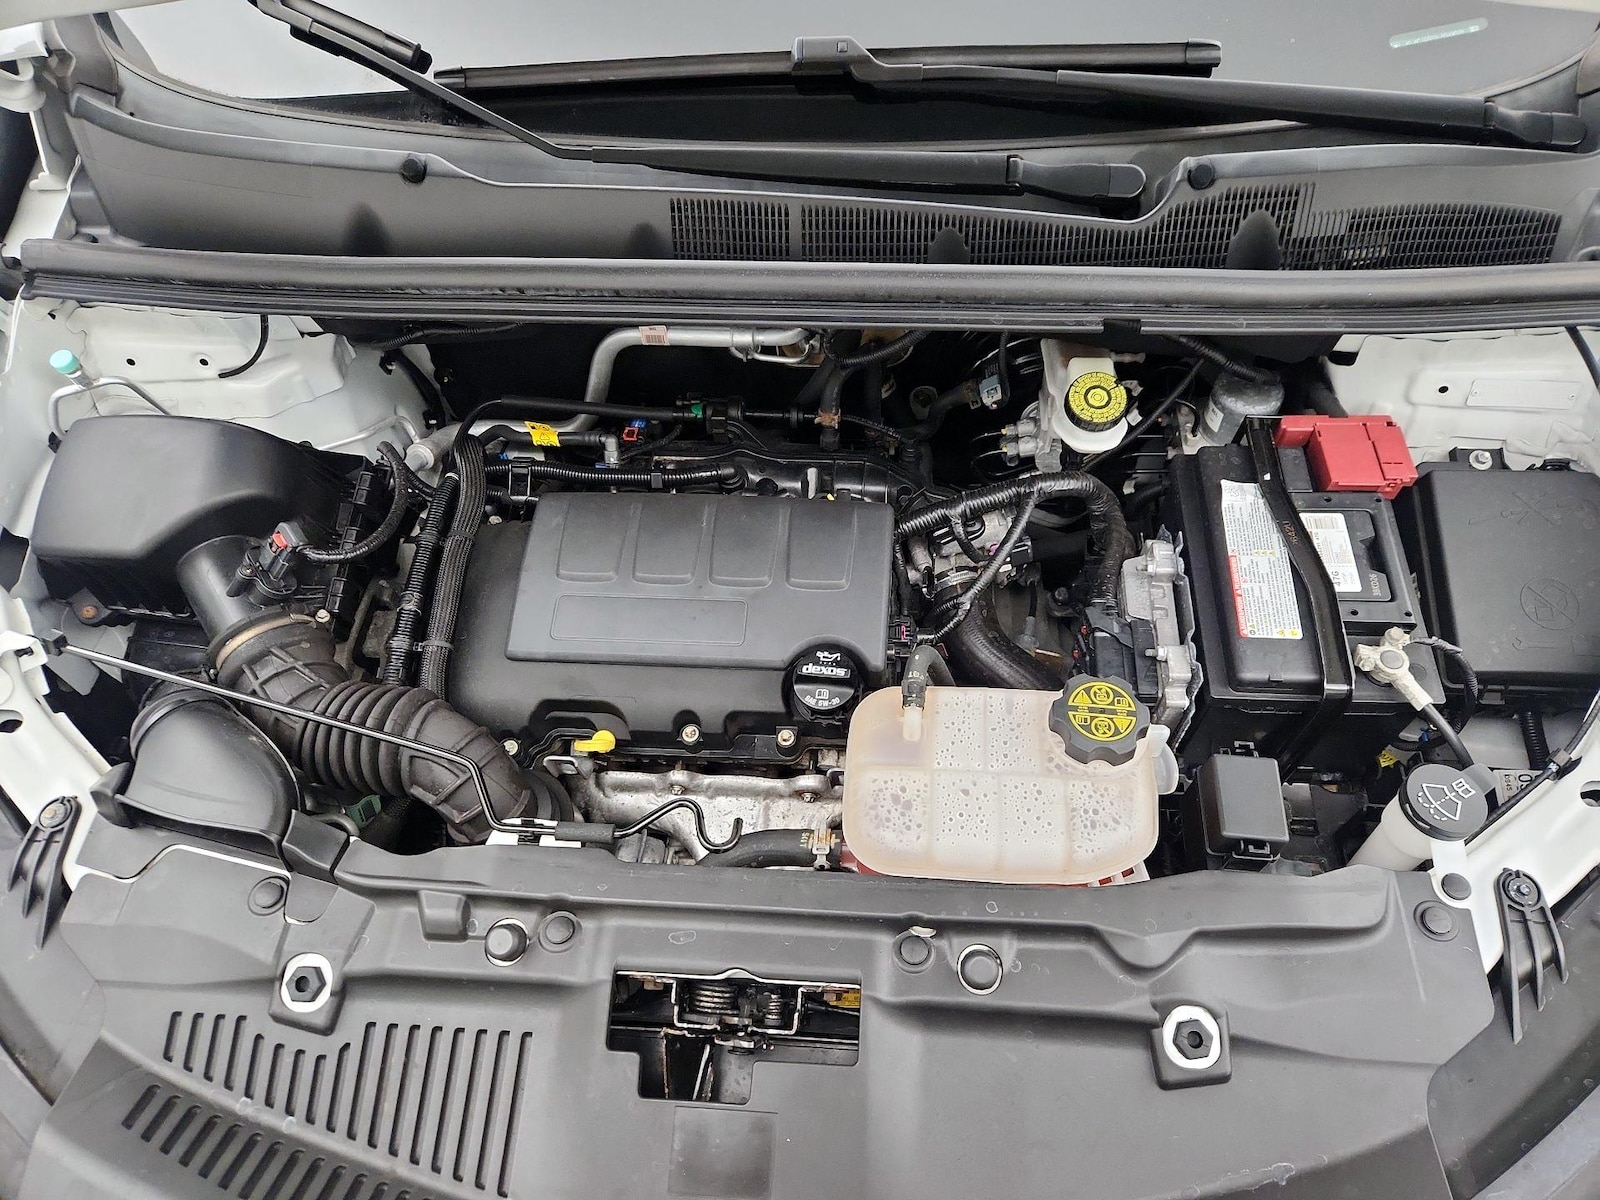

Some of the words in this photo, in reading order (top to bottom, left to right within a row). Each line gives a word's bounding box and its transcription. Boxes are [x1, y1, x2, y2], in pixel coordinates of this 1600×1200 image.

[802, 663, 848, 677] dexos
[804, 694, 818, 706] SAE
[818, 697, 840, 707] 5W-30
